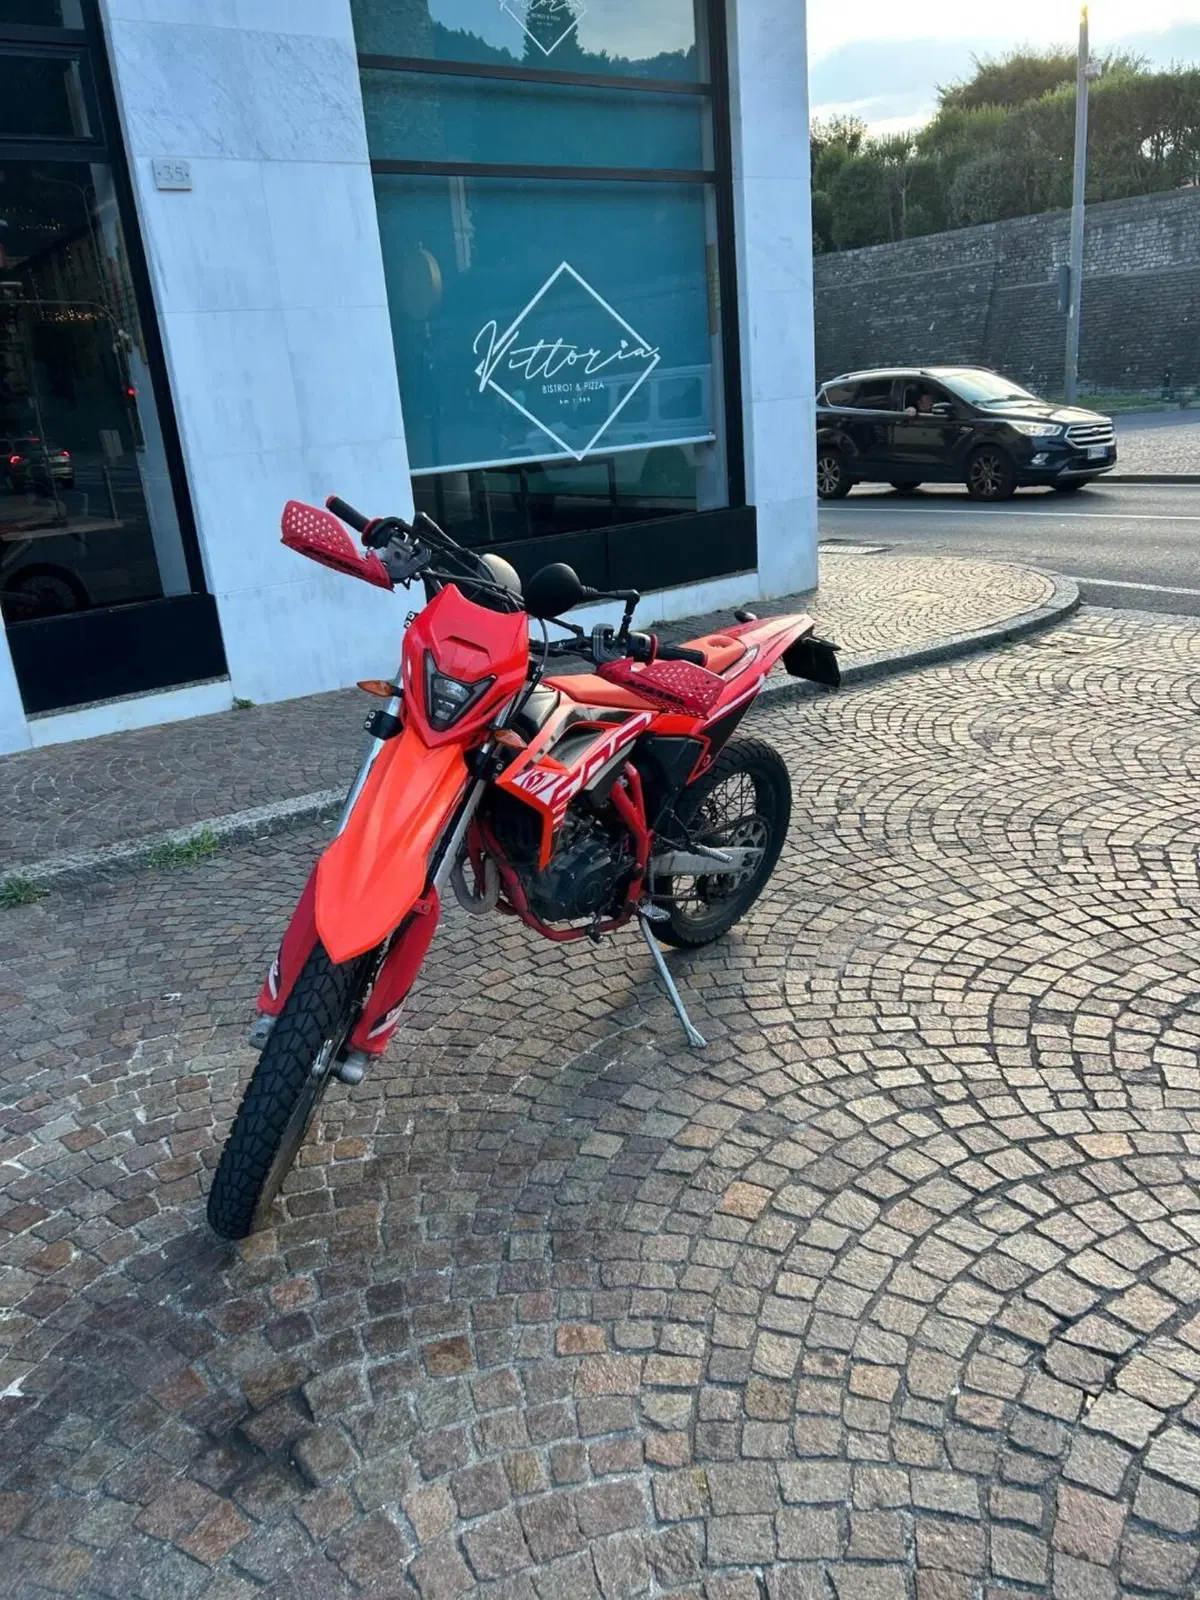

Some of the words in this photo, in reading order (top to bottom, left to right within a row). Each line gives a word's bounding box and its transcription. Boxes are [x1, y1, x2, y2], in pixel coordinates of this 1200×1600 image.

[473, 319, 660, 393] Vittoria
[541, 382, 573, 395] BISTROT
[583, 380, 605, 391] PIZZA
